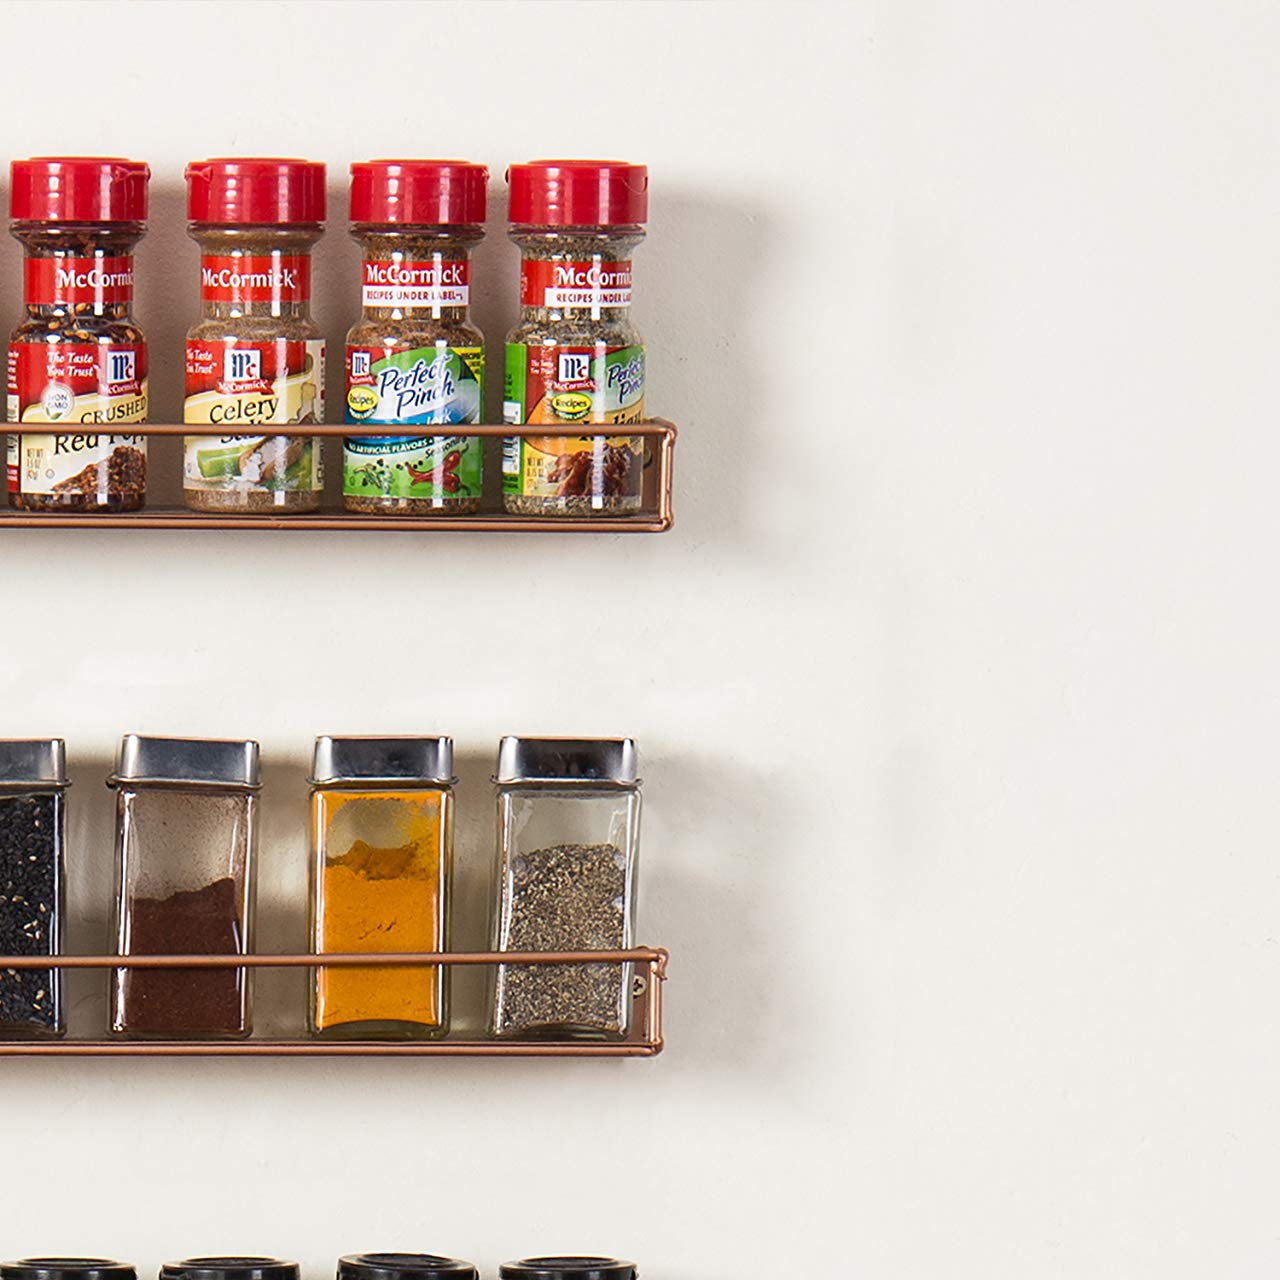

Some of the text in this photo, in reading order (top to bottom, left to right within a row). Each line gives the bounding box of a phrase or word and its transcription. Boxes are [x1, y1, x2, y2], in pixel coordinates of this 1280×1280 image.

[202, 267, 295, 290] McCormick
[366, 264, 462, 285] McCormick
[367, 291, 393, 300] RECIPES
[399, 291, 429, 300] UNDER
[556, 293, 593, 303] RECIPES
[48, 351, 94, 364] The Taste
[47, 364, 95, 378] You Trust
[381, 355, 452, 397] Perfect
[397, 371, 454, 417] Pinch
[210, 399, 278, 424] Celery
[555, 397, 588, 410] Recipes
